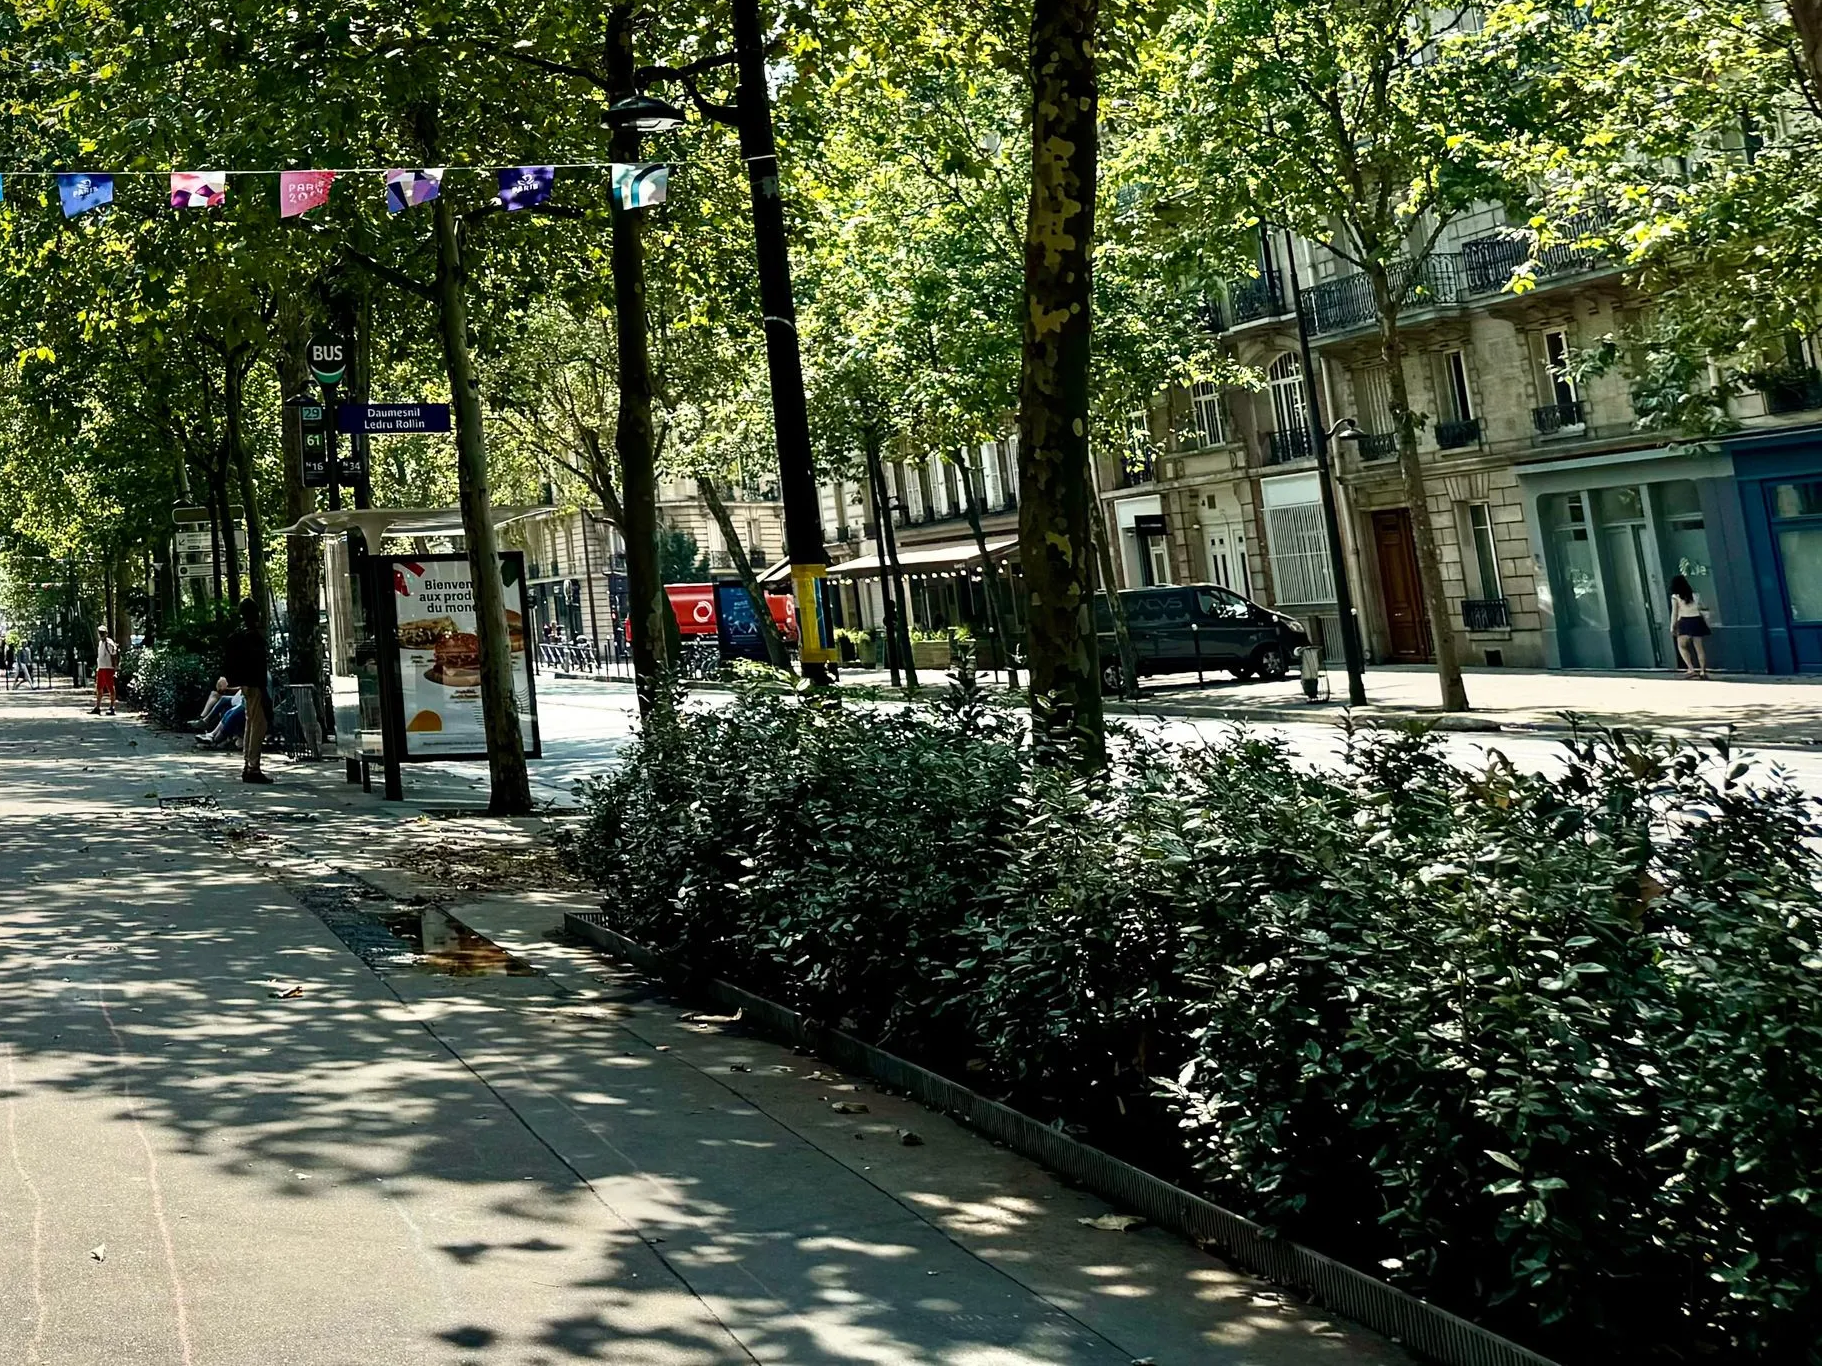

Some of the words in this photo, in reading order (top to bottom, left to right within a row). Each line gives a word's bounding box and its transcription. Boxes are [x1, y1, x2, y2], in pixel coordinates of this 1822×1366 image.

[288, 180, 325, 192] PARIS
[511, 183, 539, 194] PARIS
[312, 345, 343, 361] BUS
[304, 408, 320, 419] 29
[368, 407, 420, 417] Daumesnil
[364, 419, 393, 429] Ledru
[396, 419, 425, 429] Rollin
[306, 434, 320, 446] 61
[425, 579, 474, 590] Bienven
[419, 593, 441, 602] aux
[444, 590, 473, 603] prod
[427, 602, 442, 613] du
